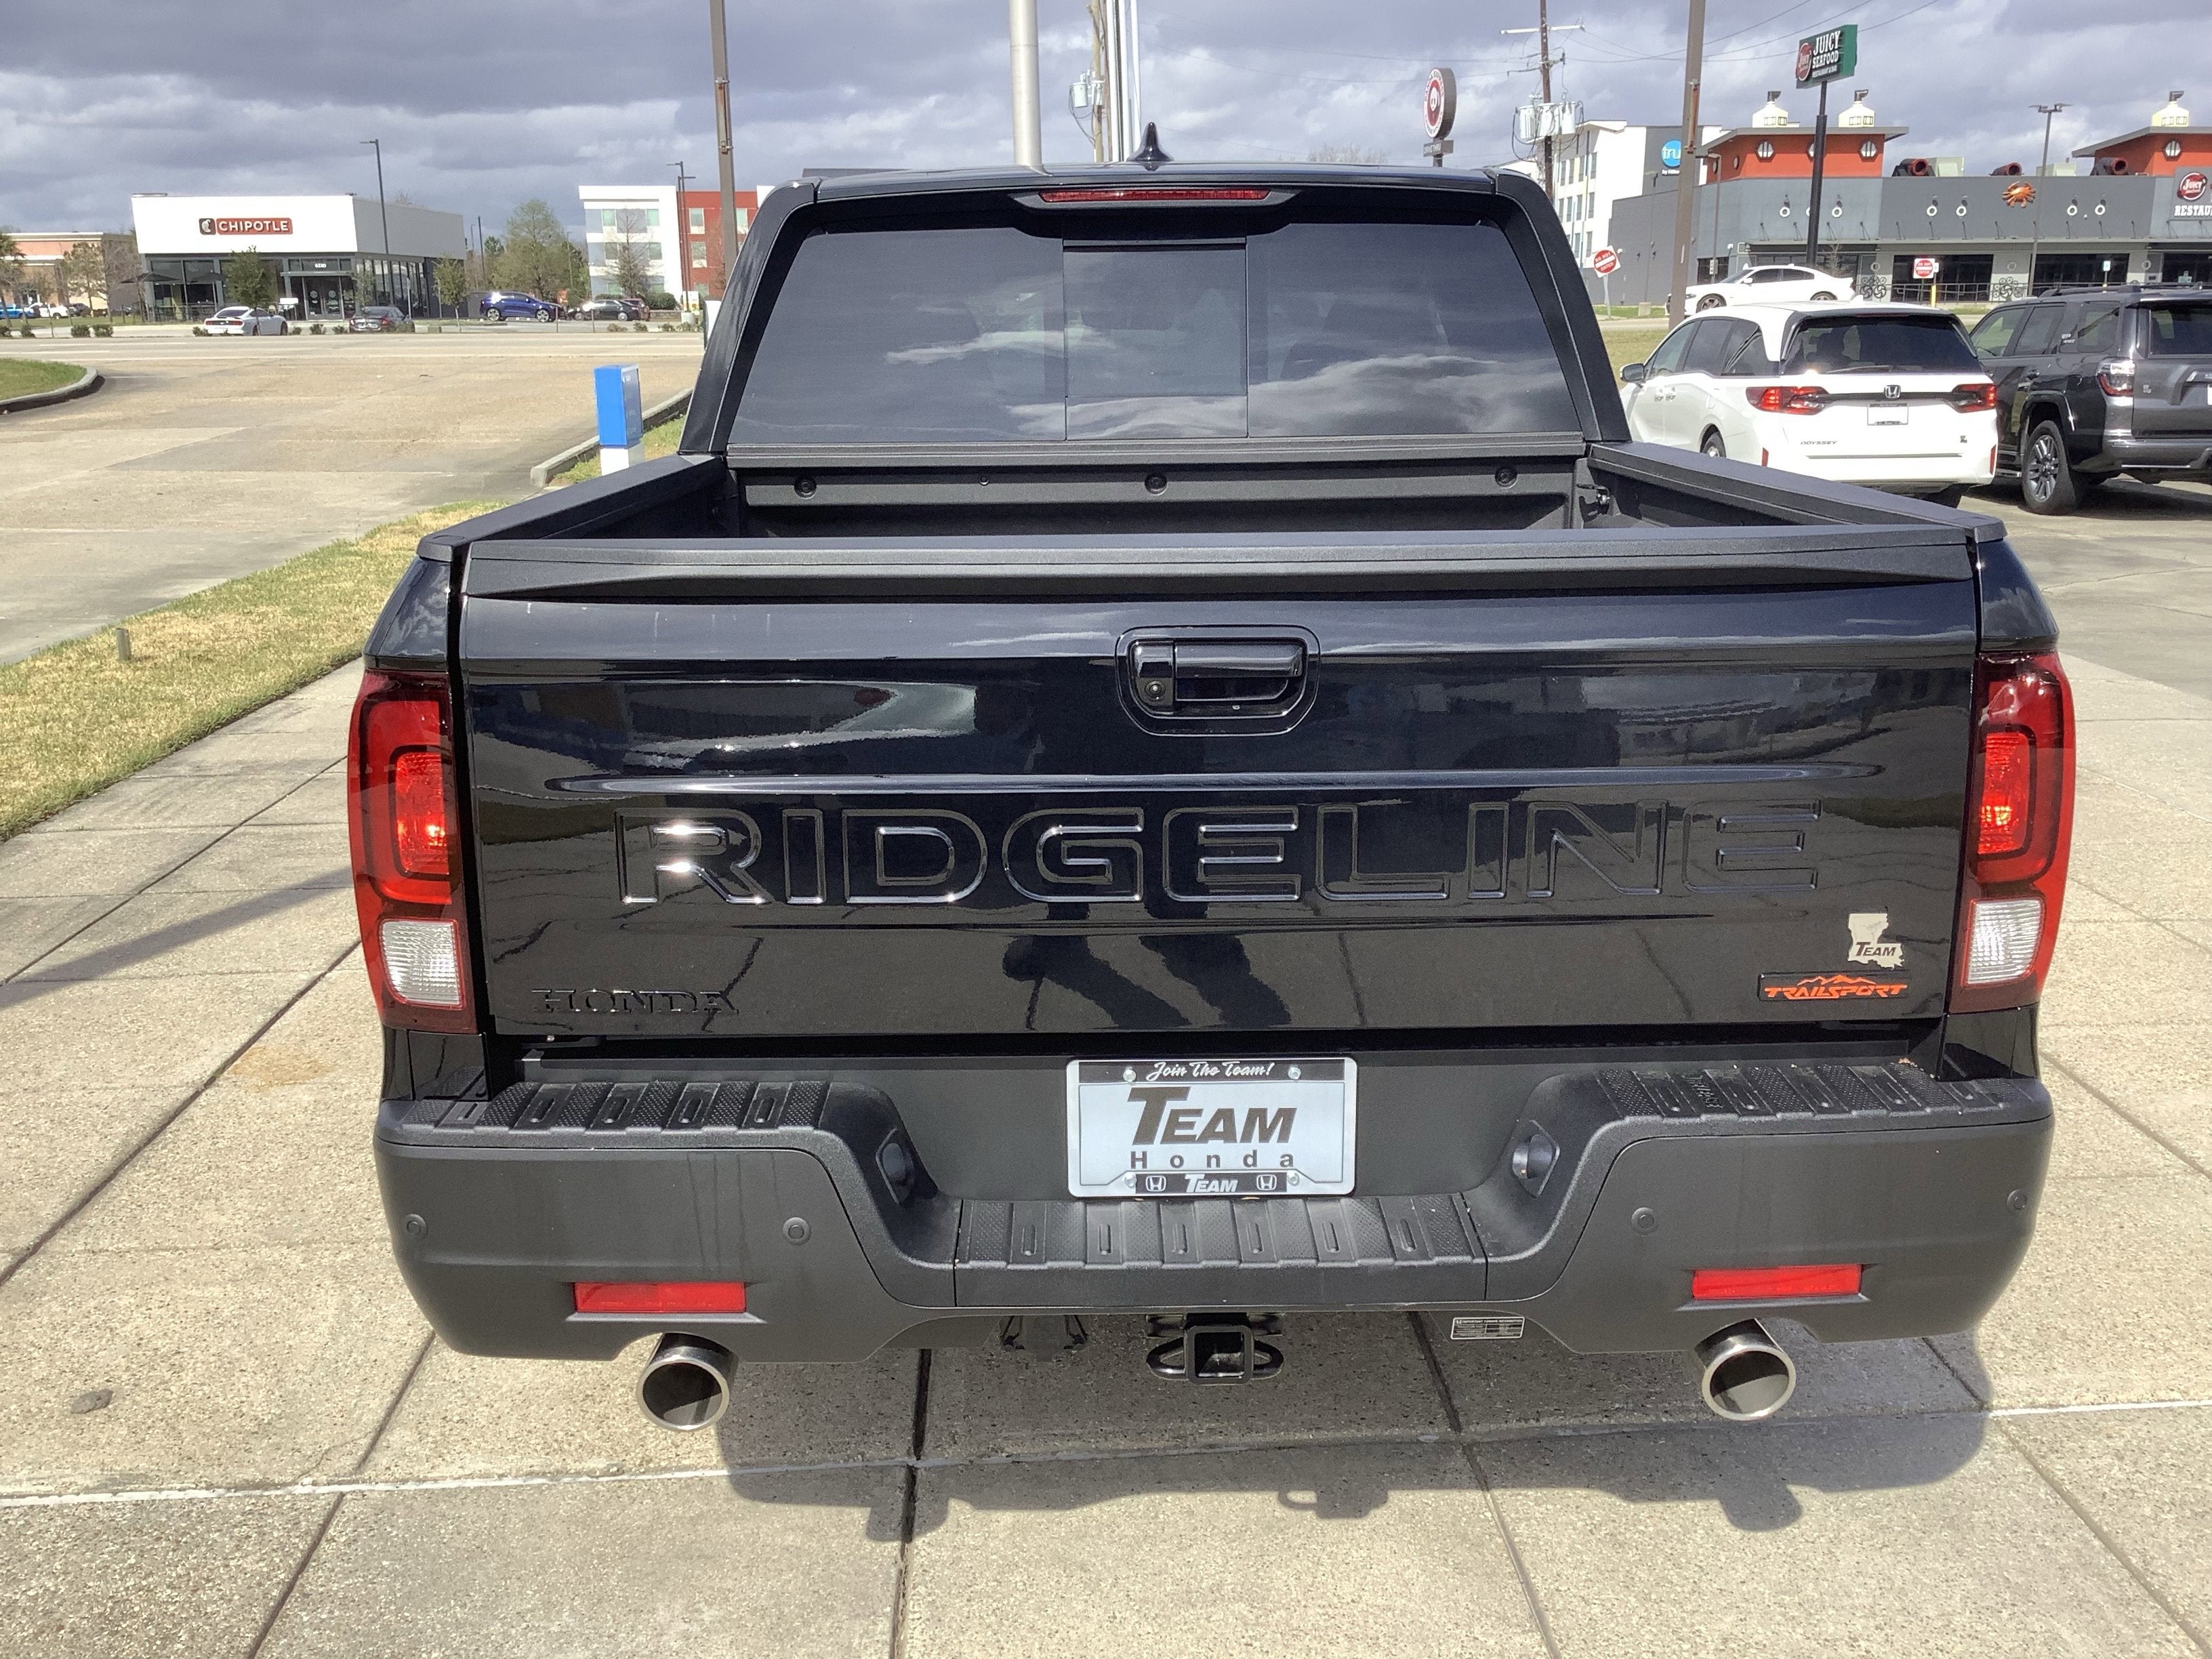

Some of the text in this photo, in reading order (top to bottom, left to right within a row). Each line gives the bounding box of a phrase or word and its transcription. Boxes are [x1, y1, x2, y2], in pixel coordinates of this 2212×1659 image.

[1814, 30, 1841, 56] JUICY
[1812, 50, 1839, 68] SEAFOOD
[2174, 205, 2212, 216] RESTAU
[219, 221, 289, 231] CHIPOTLE
[614, 798, 1823, 904] RIDGELINE
[1856, 941, 1896, 956] TEAM
[532, 988, 740, 1015] HONDA
[1765, 985, 1908, 1000] TRAILSPORT
[1146, 1061, 1275, 1082] Join The Team!
[1127, 1086, 1297, 1145] TEAM
[1130, 1149, 1294, 1169] Honda
[1185, 1173, 1238, 1193] TEAM
